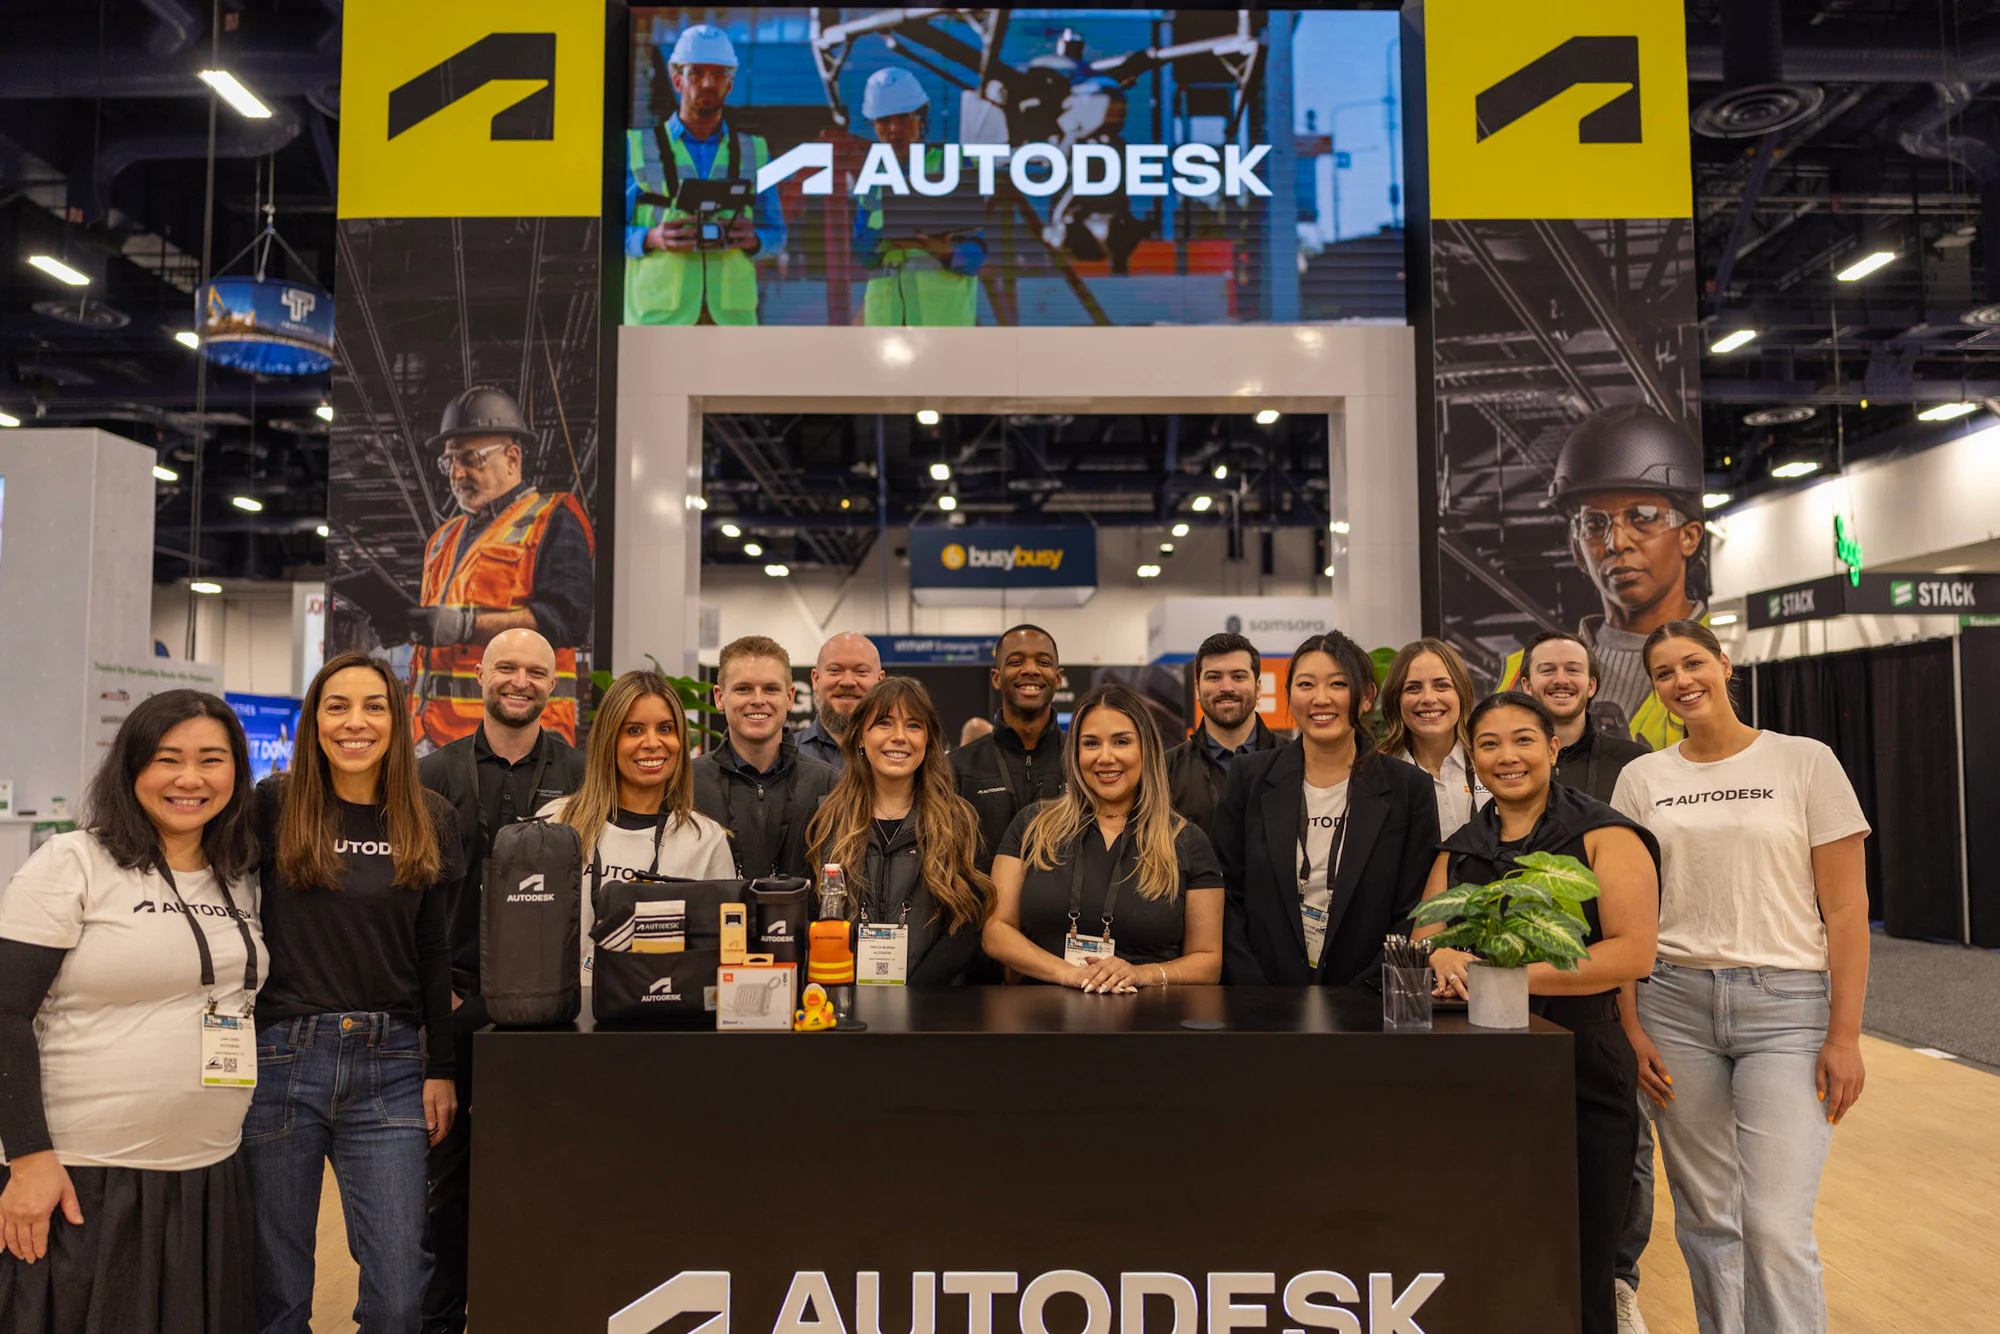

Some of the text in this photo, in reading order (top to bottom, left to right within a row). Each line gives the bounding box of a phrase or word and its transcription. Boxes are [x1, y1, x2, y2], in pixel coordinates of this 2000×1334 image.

[853, 143, 1273, 196] AUTODESK
[968, 545, 1064, 571] busybusy
[1919, 581, 1976, 606] STACK
[1782, 589, 1815, 617] STACK
[1250, 619, 1325, 632] samsara
[1676, 788, 1775, 806] AUTODESK
[507, 893, 555, 902] AUTODESK
[645, 922, 680, 930] AUTODESK
[760, 935, 795, 943] AUTODESK
[641, 993, 682, 1003] AUTODESK
[772, 1269, 1446, 1334] AUTODESK
